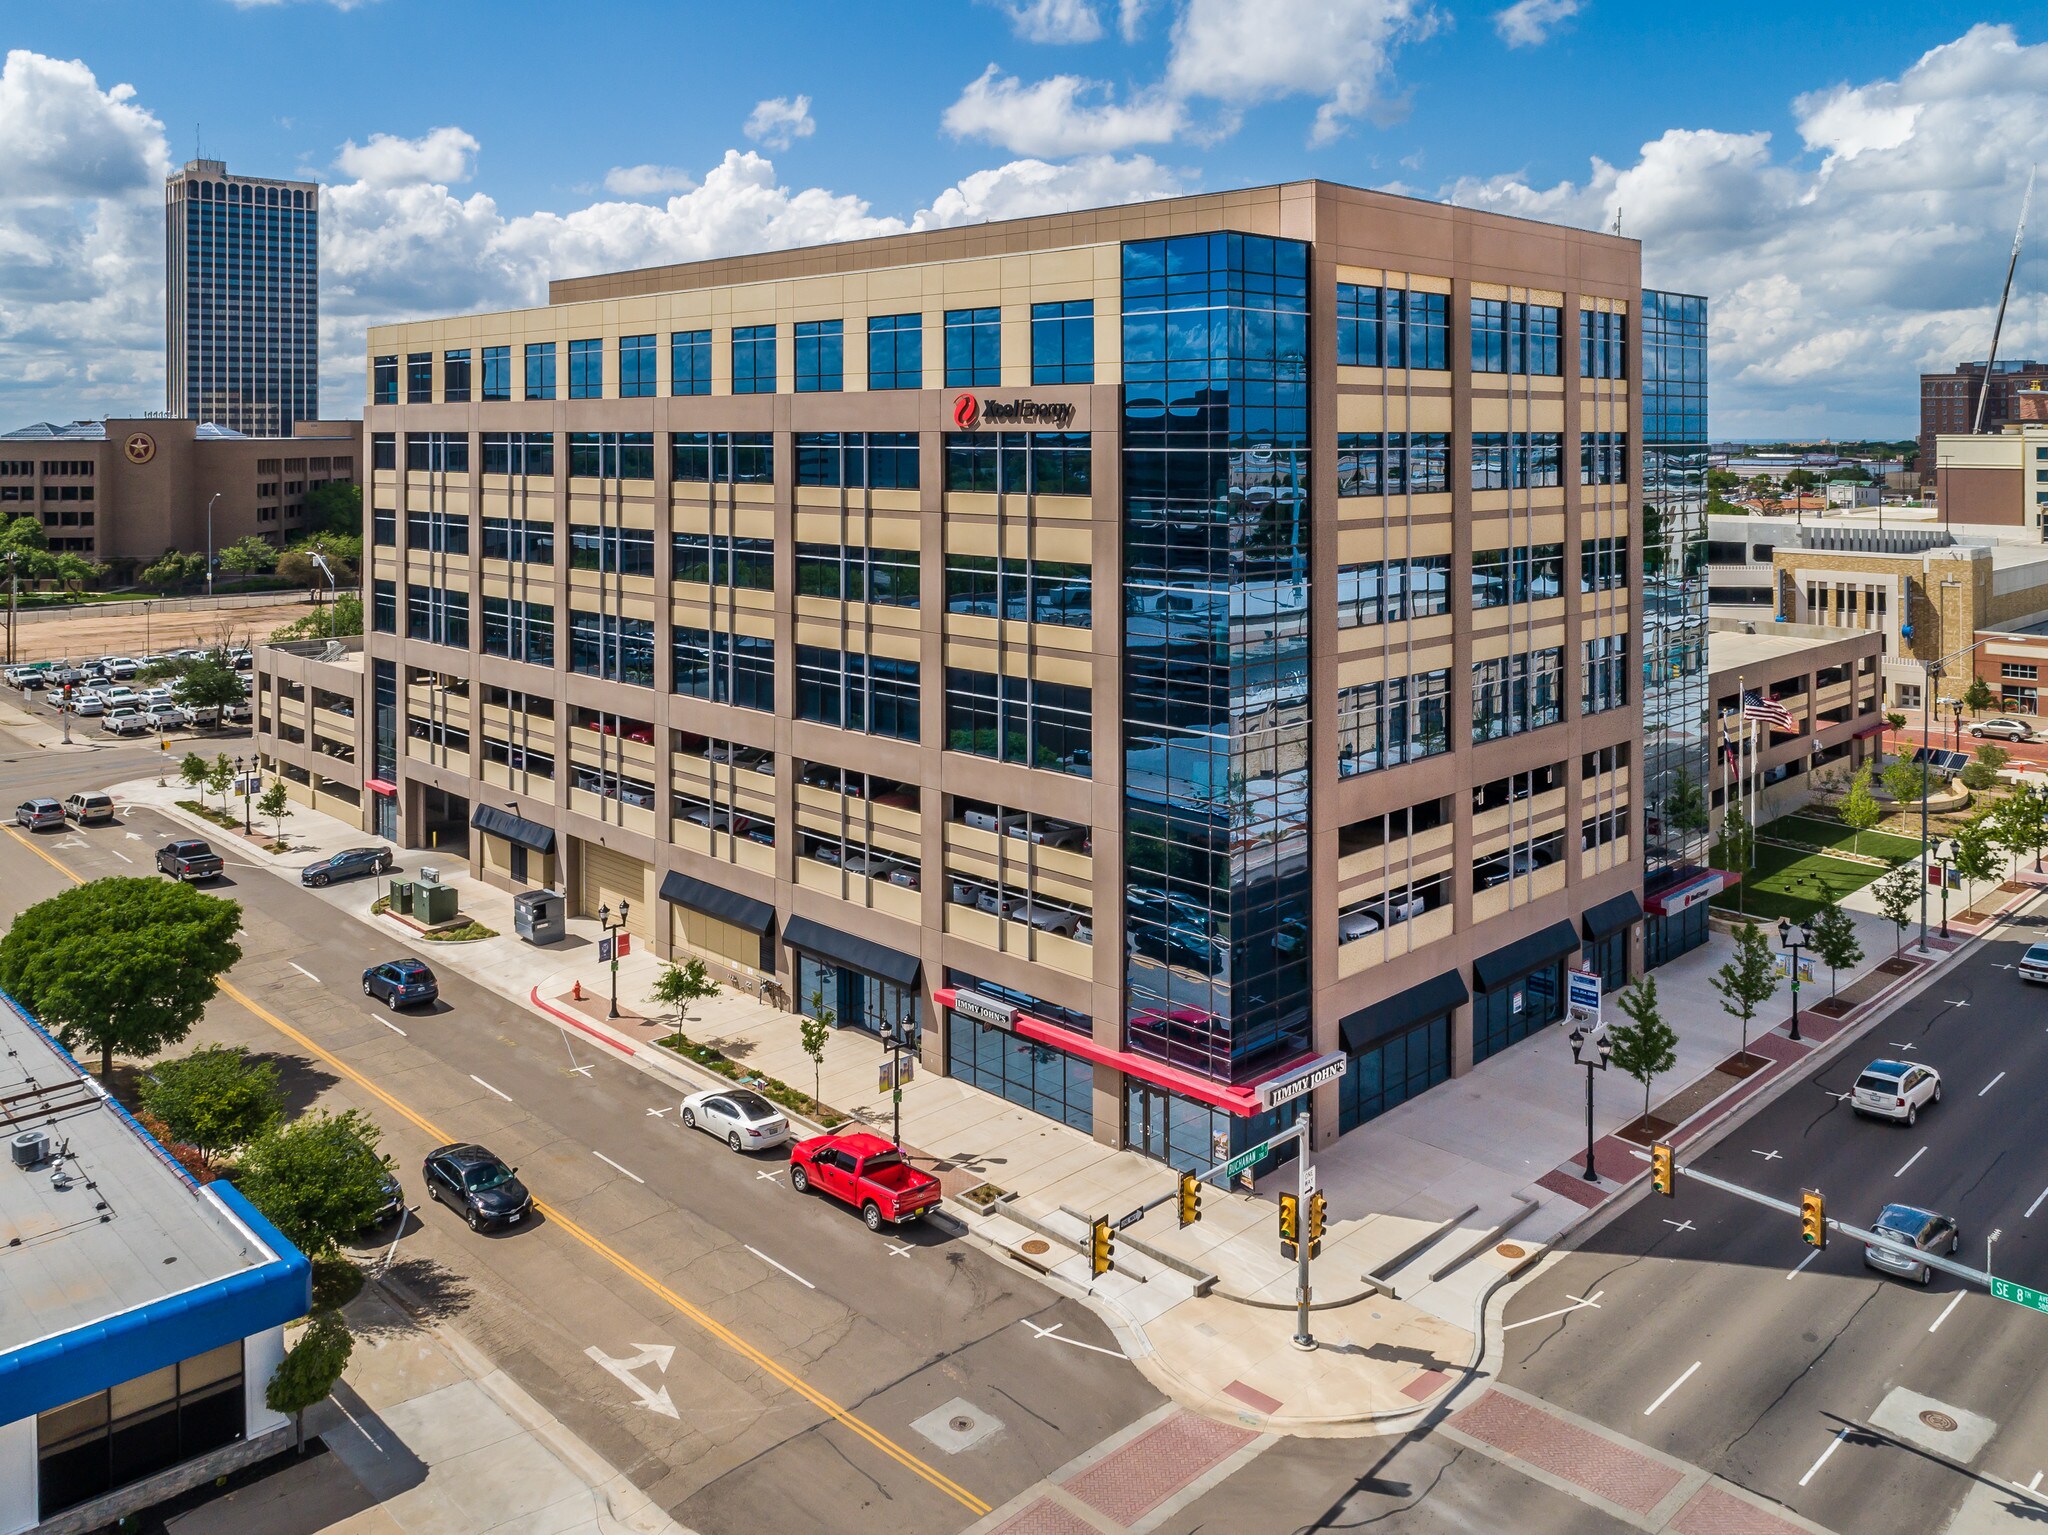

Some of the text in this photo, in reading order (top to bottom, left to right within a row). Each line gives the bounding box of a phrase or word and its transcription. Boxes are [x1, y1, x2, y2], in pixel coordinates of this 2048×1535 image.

[955, 998, 1006, 1023] JIMMY JOHN'S
[1272, 1060, 1345, 1107] JIMMY JOHN'S
[1228, 1150, 1256, 1175] BUCHANAN
[1996, 1281, 2009, 1298] SE
[2016, 1288, 2031, 1302] 8TH
